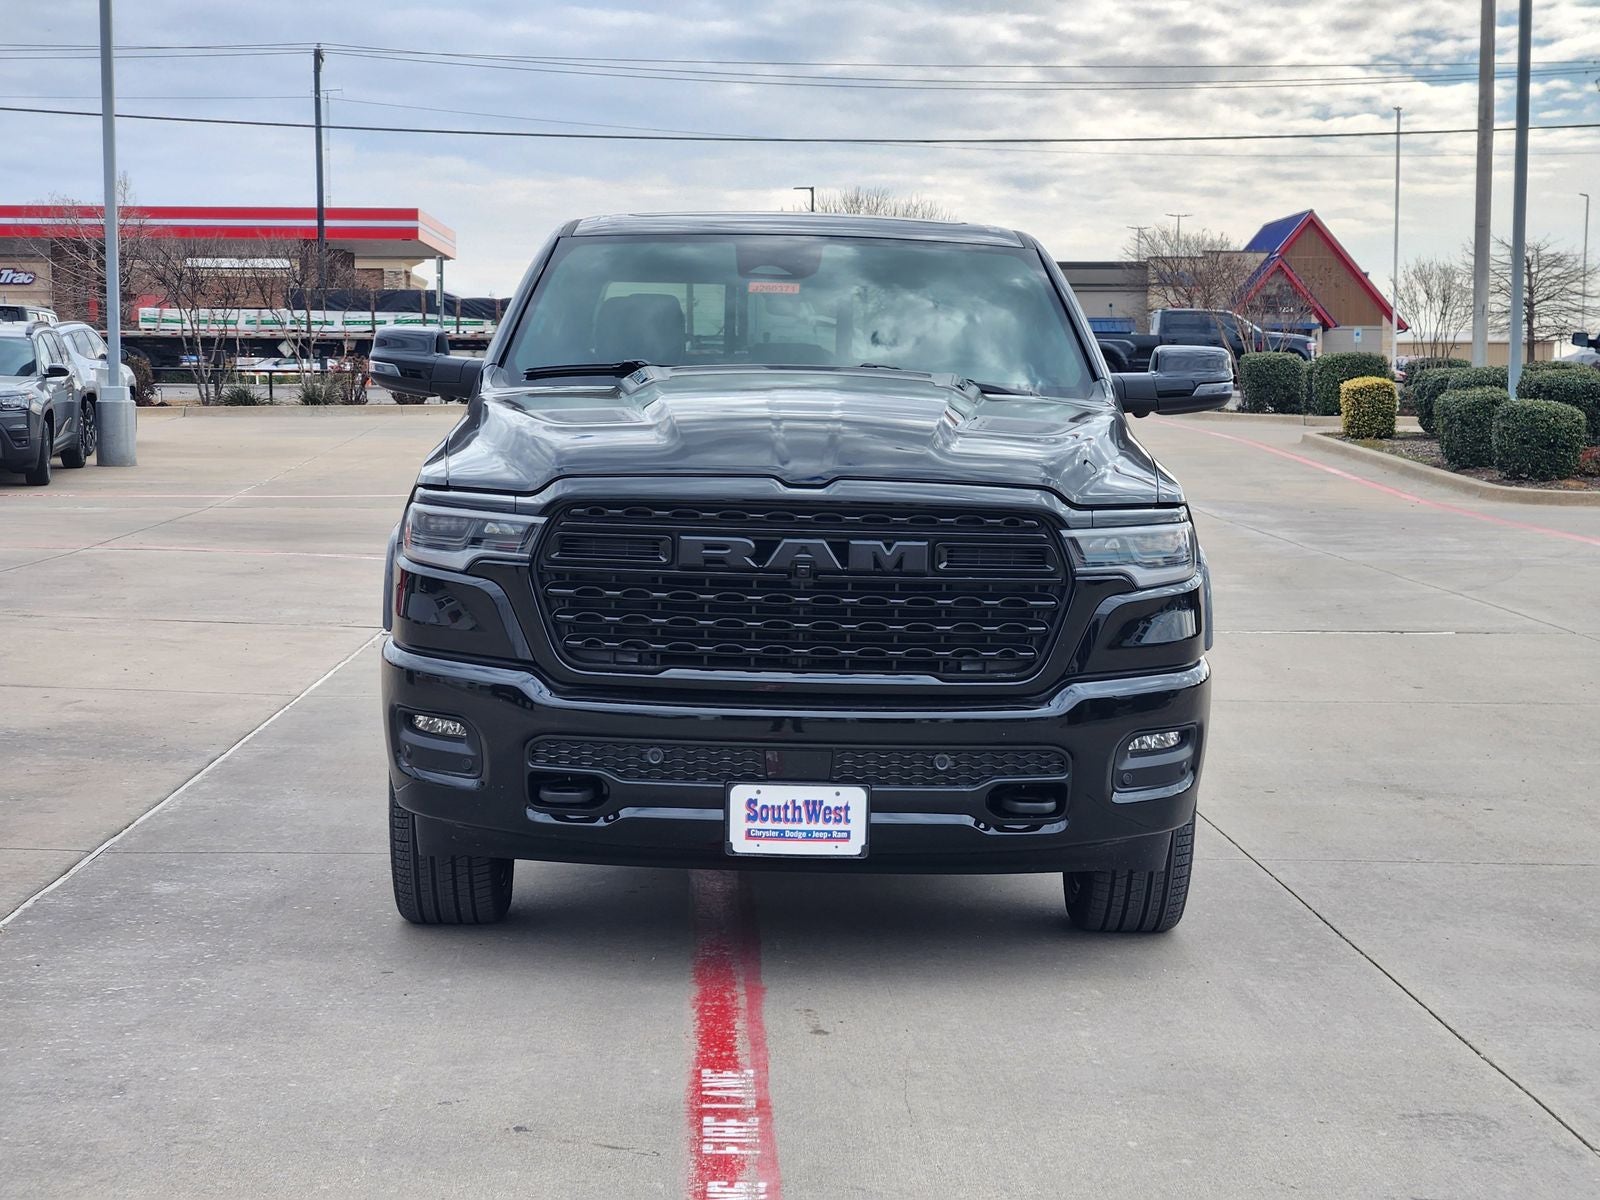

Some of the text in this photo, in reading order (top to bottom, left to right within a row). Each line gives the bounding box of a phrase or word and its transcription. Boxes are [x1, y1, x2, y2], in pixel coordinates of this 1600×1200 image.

[678, 535, 929, 572] RAM
[745, 797, 851, 825] SouthWest
[750, 829, 779, 838] Chrysler
[785, 830, 807, 838] Dodge
[812, 831, 828, 839] Jeep
[701, 1069, 756, 1109] LANE
[702, 1116, 761, 1155] FIRE
